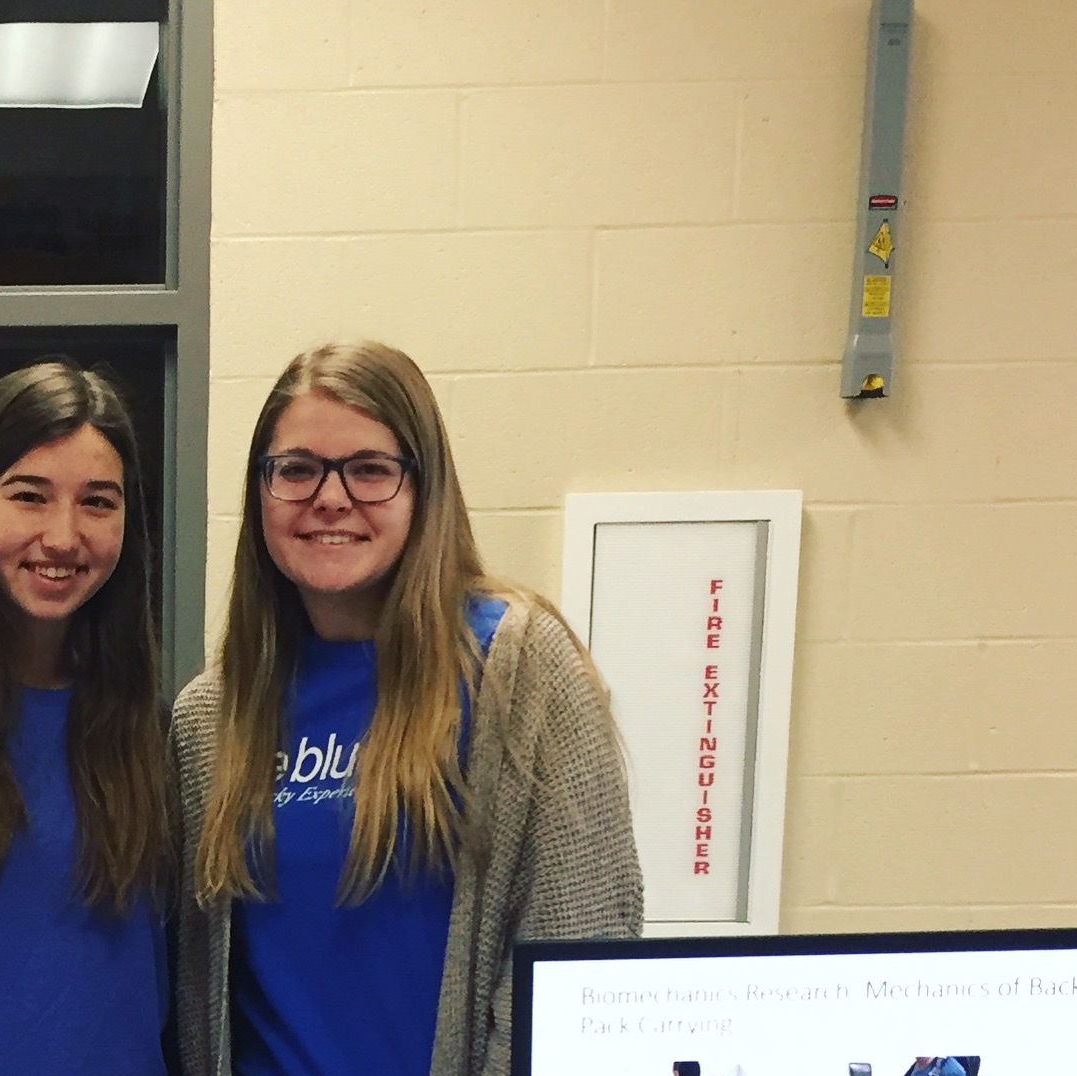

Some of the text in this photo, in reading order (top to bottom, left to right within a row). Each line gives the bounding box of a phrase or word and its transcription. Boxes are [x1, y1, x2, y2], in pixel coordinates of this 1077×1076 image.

[693, 578, 724, 876] FIRE EXTINGUISHER
[581, 985, 738, 1006] Biomechanics
[866, 979, 991, 1000] Mechanics
[997, 976, 1021, 998] of
[581, 1016, 733, 1038] Pack Carrying
